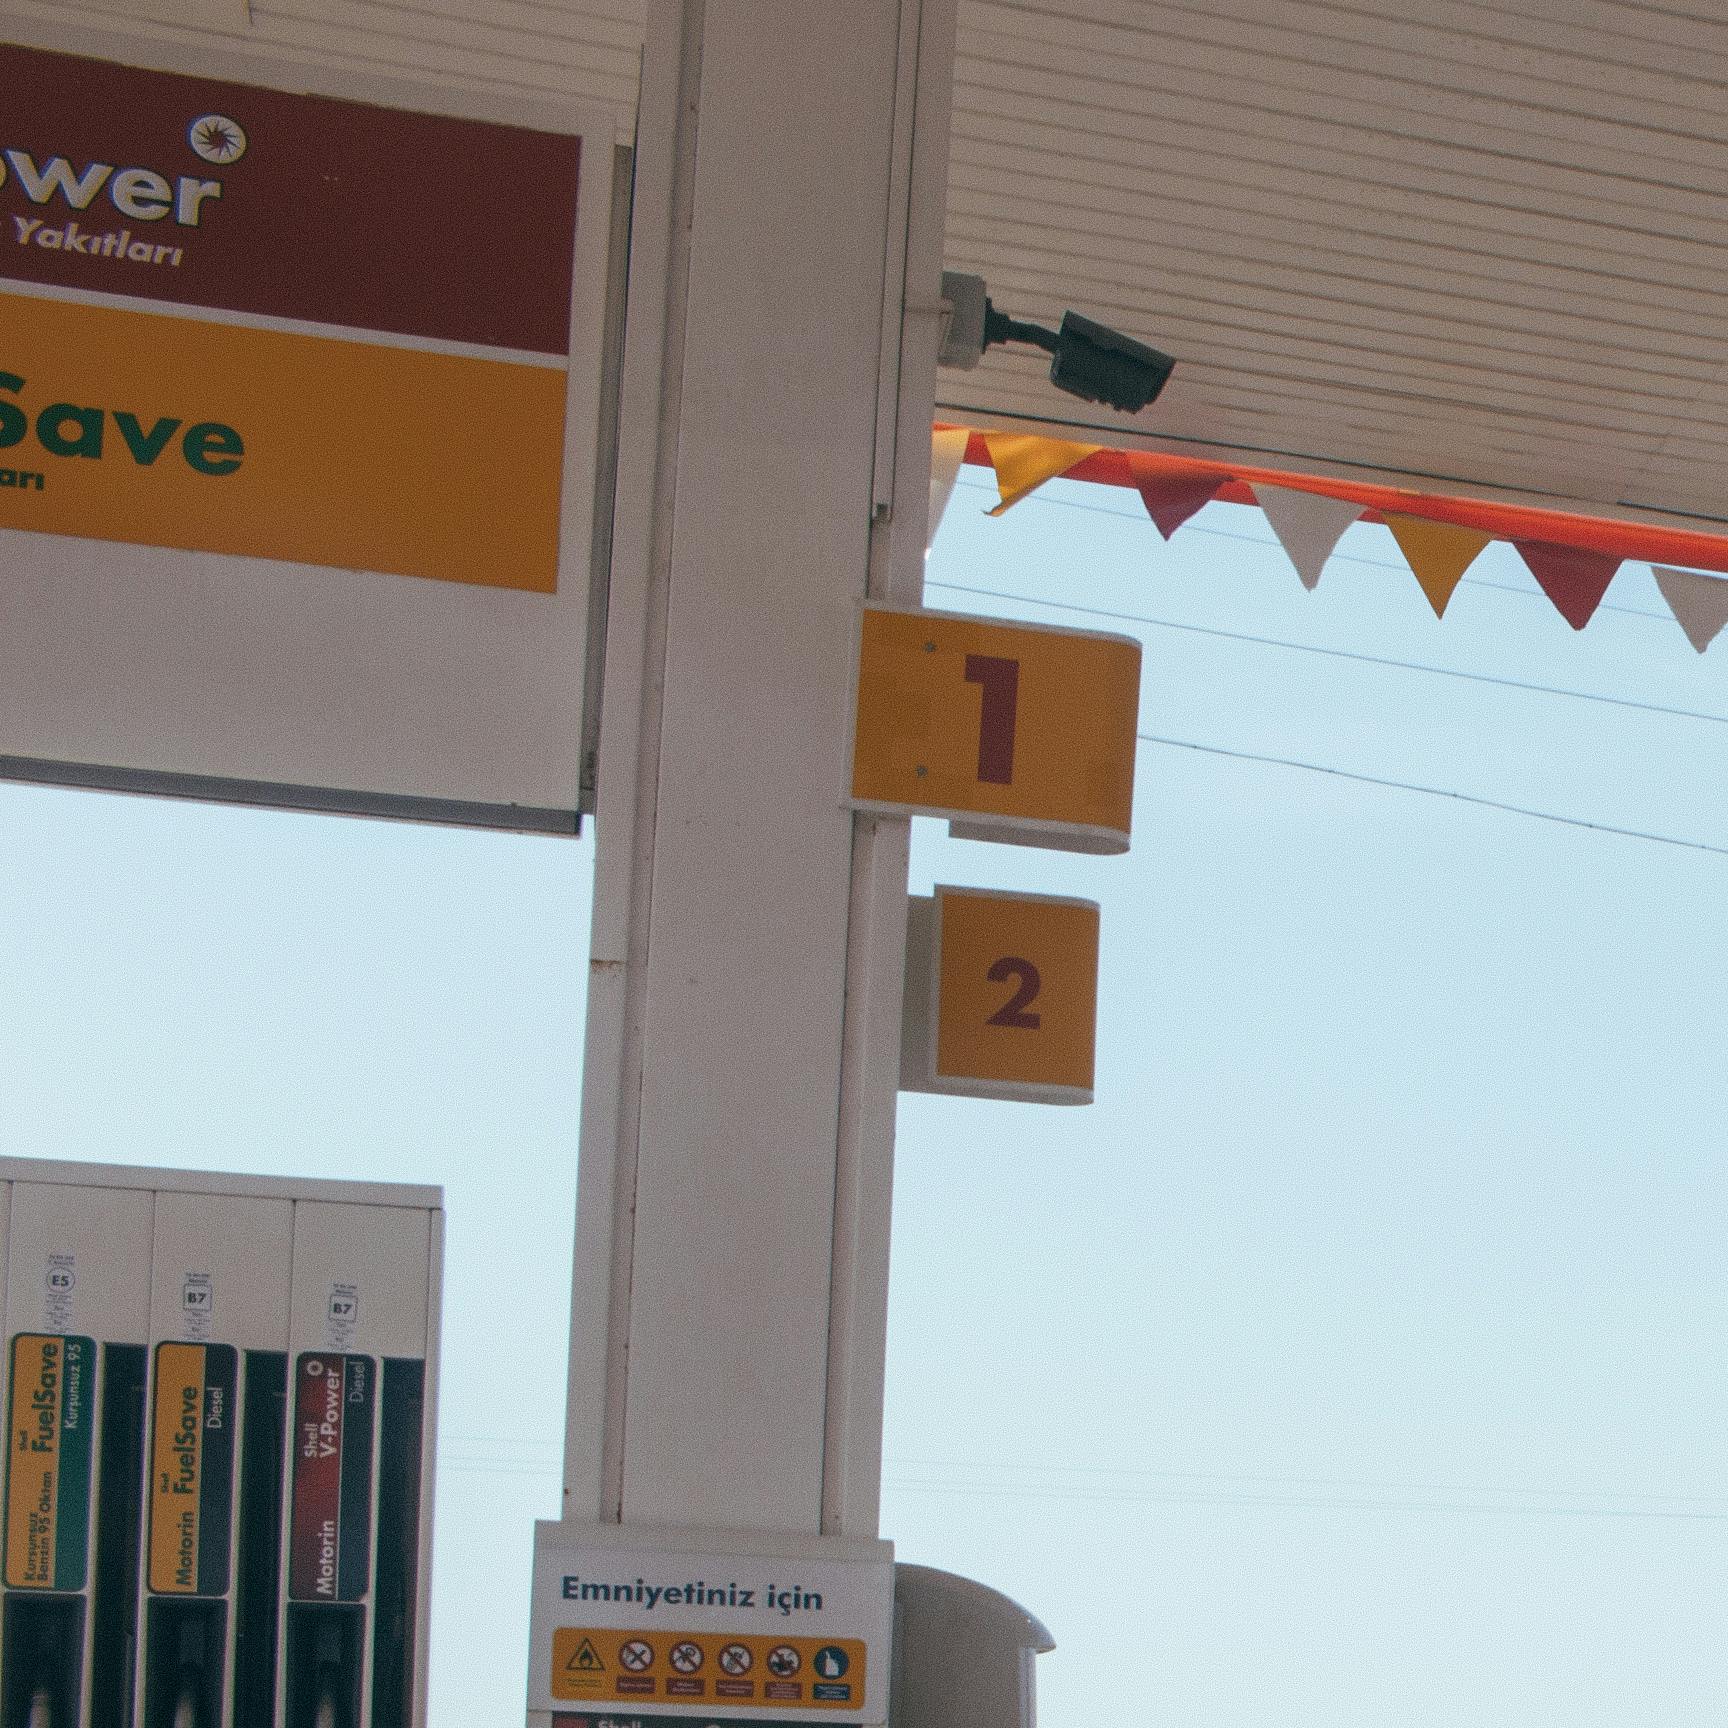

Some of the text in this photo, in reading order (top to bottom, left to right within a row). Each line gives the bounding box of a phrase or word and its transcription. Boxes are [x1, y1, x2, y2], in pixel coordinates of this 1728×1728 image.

[0, 148, 222, 226] wer
[13, 215, 183, 266] Yakıtları
[965, 654, 1019, 785] 1
[986, 957, 1041, 1029] 2
[67, 1343, 82, 1362] 95
[349, 1360, 366, 1404] Diesel
[31, 1343, 58, 1453] FuelSave
[207, 1386, 223, 1429] Diesel
[320, 1368, 340, 1459] V-Power
[173, 1386, 198, 1495] FuelSave
[304, 1423, 319, 1459] Shell
[37, 1471, 51, 1582] Benzin 95 Oktan
[175, 1511, 193, 1587] Motorin
[317, 1520, 335, 1596] Motorin
[561, 1575, 823, 1617] Emniyetiniz için
